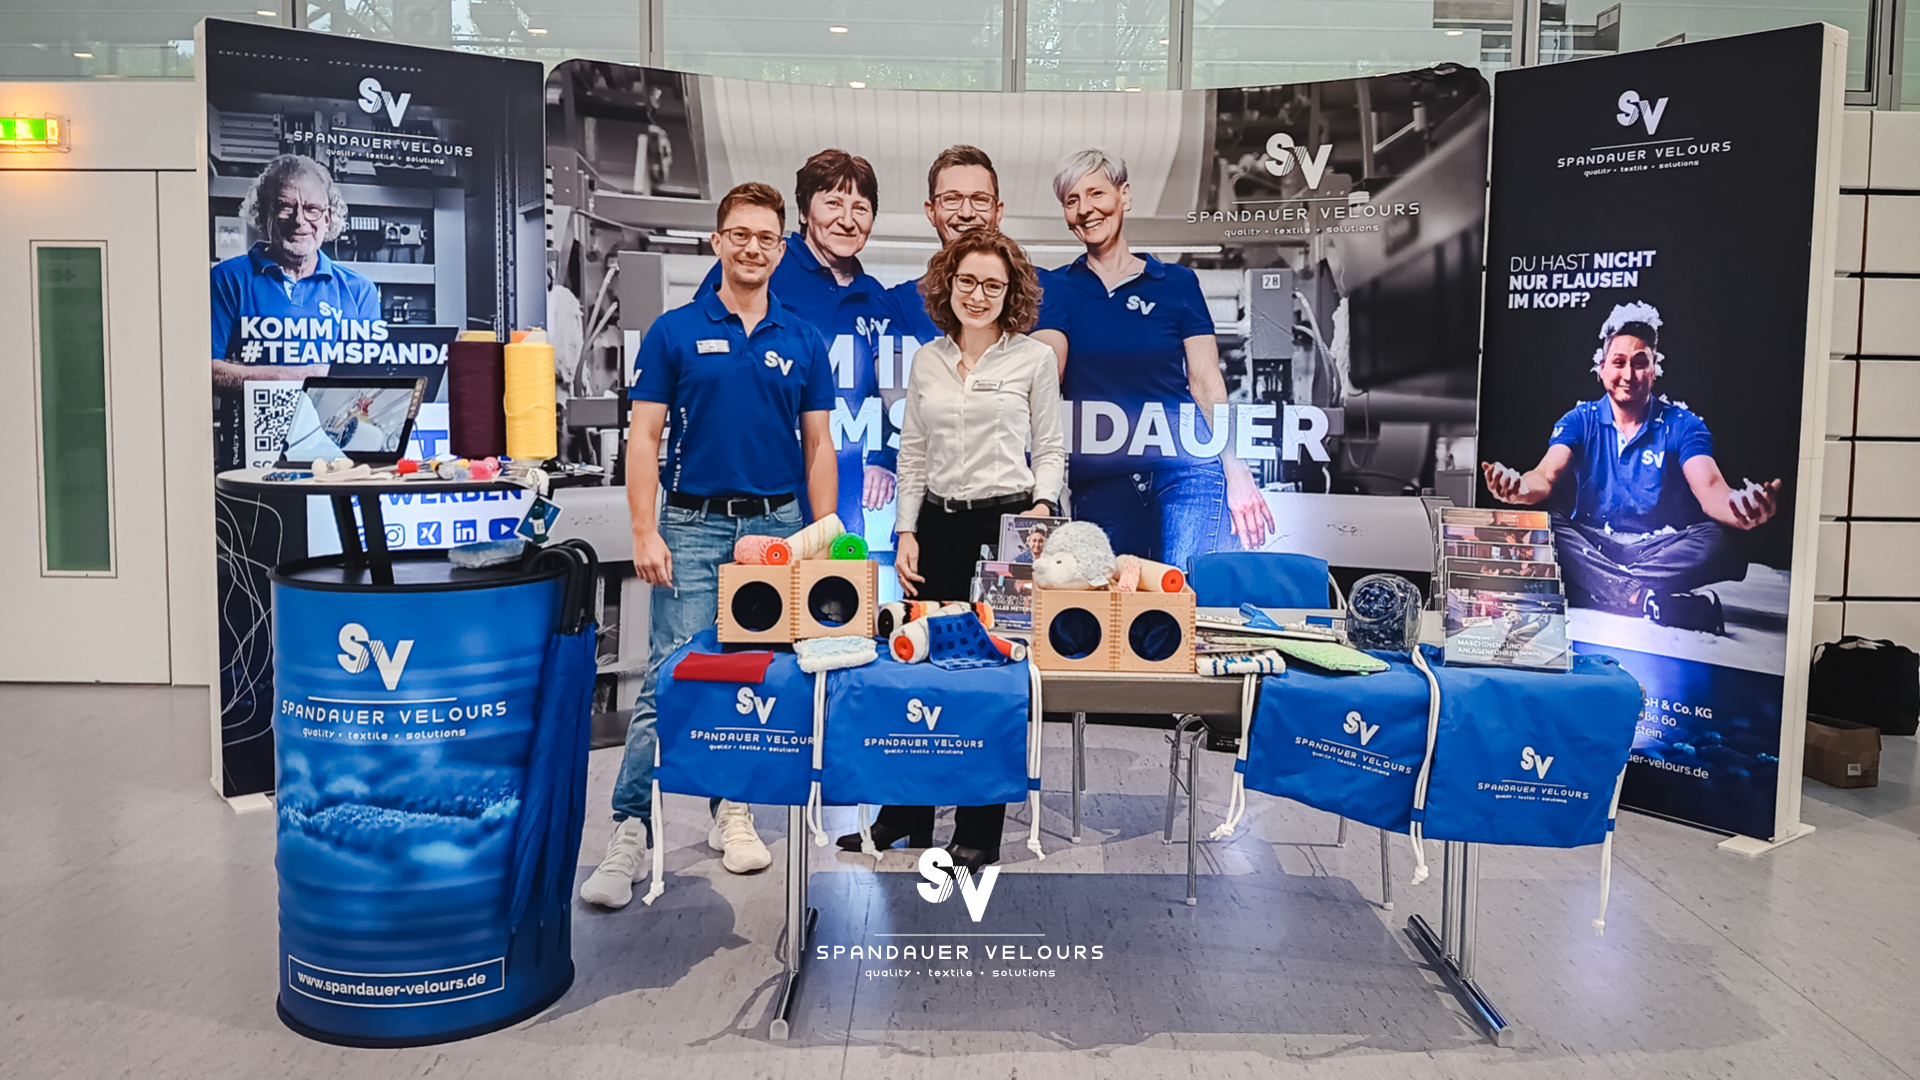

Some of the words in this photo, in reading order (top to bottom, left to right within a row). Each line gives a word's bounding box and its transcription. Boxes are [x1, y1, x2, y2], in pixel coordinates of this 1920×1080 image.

[358, 77, 411, 127] SV
[1616, 90, 1669, 135] SV
[293, 131, 392, 149] SPANDAUER
[401, 141, 473, 157] VELOURS
[1557, 150, 1647, 168] SPANDAUER
[1655, 141, 1732, 158] VELOURS
[326, 149, 355, 157] quality
[366, 152, 394, 160] textile
[406, 156, 445, 165] solutions
[1264, 132, 1333, 189] SV
[1584, 168, 1612, 178] quality
[1621, 164, 1648, 173] textile
[1659, 160, 1700, 170] solutions
[1186, 207, 1308, 223] SPANDAUER
[1320, 202, 1421, 220] VELOURS
[1224, 228, 1262, 238] quality
[1274, 227, 1310, 235] textile
[1326, 224, 1379, 233] solutions
[1510, 256, 1537, 273] DU
[1541, 253, 1590, 271] HAST
[1593, 250, 1657, 269] NICHT
[1264, 277, 1279, 286] 28
[1509, 274, 1548, 291] NUR
[1552, 271, 1638, 289] FLAUSEN
[1125, 295, 1156, 316] SV
[1508, 293, 1529, 309] IM
[1533, 291, 1591, 309] KOPF?
[241, 316, 333, 340] KOMM
[341, 319, 389, 341] INS
[764, 350, 793, 377] SV
[1641, 449, 1665, 468] SV
[337, 622, 414, 691] SV
[281, 700, 385, 724] SPANDAUER
[399, 701, 507, 724] VELOURS
[736, 687, 777, 724] SV
[906, 698, 942, 731] SV
[1661, 700, 1671, 711] &
[1672, 702, 1692, 715] Co.
[1695, 706, 1713, 719] KG
[1343, 710, 1380, 746] SV
[1661, 714, 1677, 727] 60
[302, 727, 335, 739] quality
[348, 731, 388, 741] textile
[406, 728, 466, 740] solutions
[690, 730, 760, 742] SPANDAUER
[766, 735, 814, 745] VELOUR
[864, 738, 928, 747] SPANDAUER
[934, 739, 984, 748] VELOURS
[1294, 736, 1357, 760] SPANDAUER
[1362, 754, 1412, 774] VELOURS
[1520, 746, 1554, 779] SV
[1478, 782, 1536, 793] SPANDAUER
[1541, 788, 1589, 800] VELOURS
[297, 971, 487, 997] www.spandauer-velours.de
